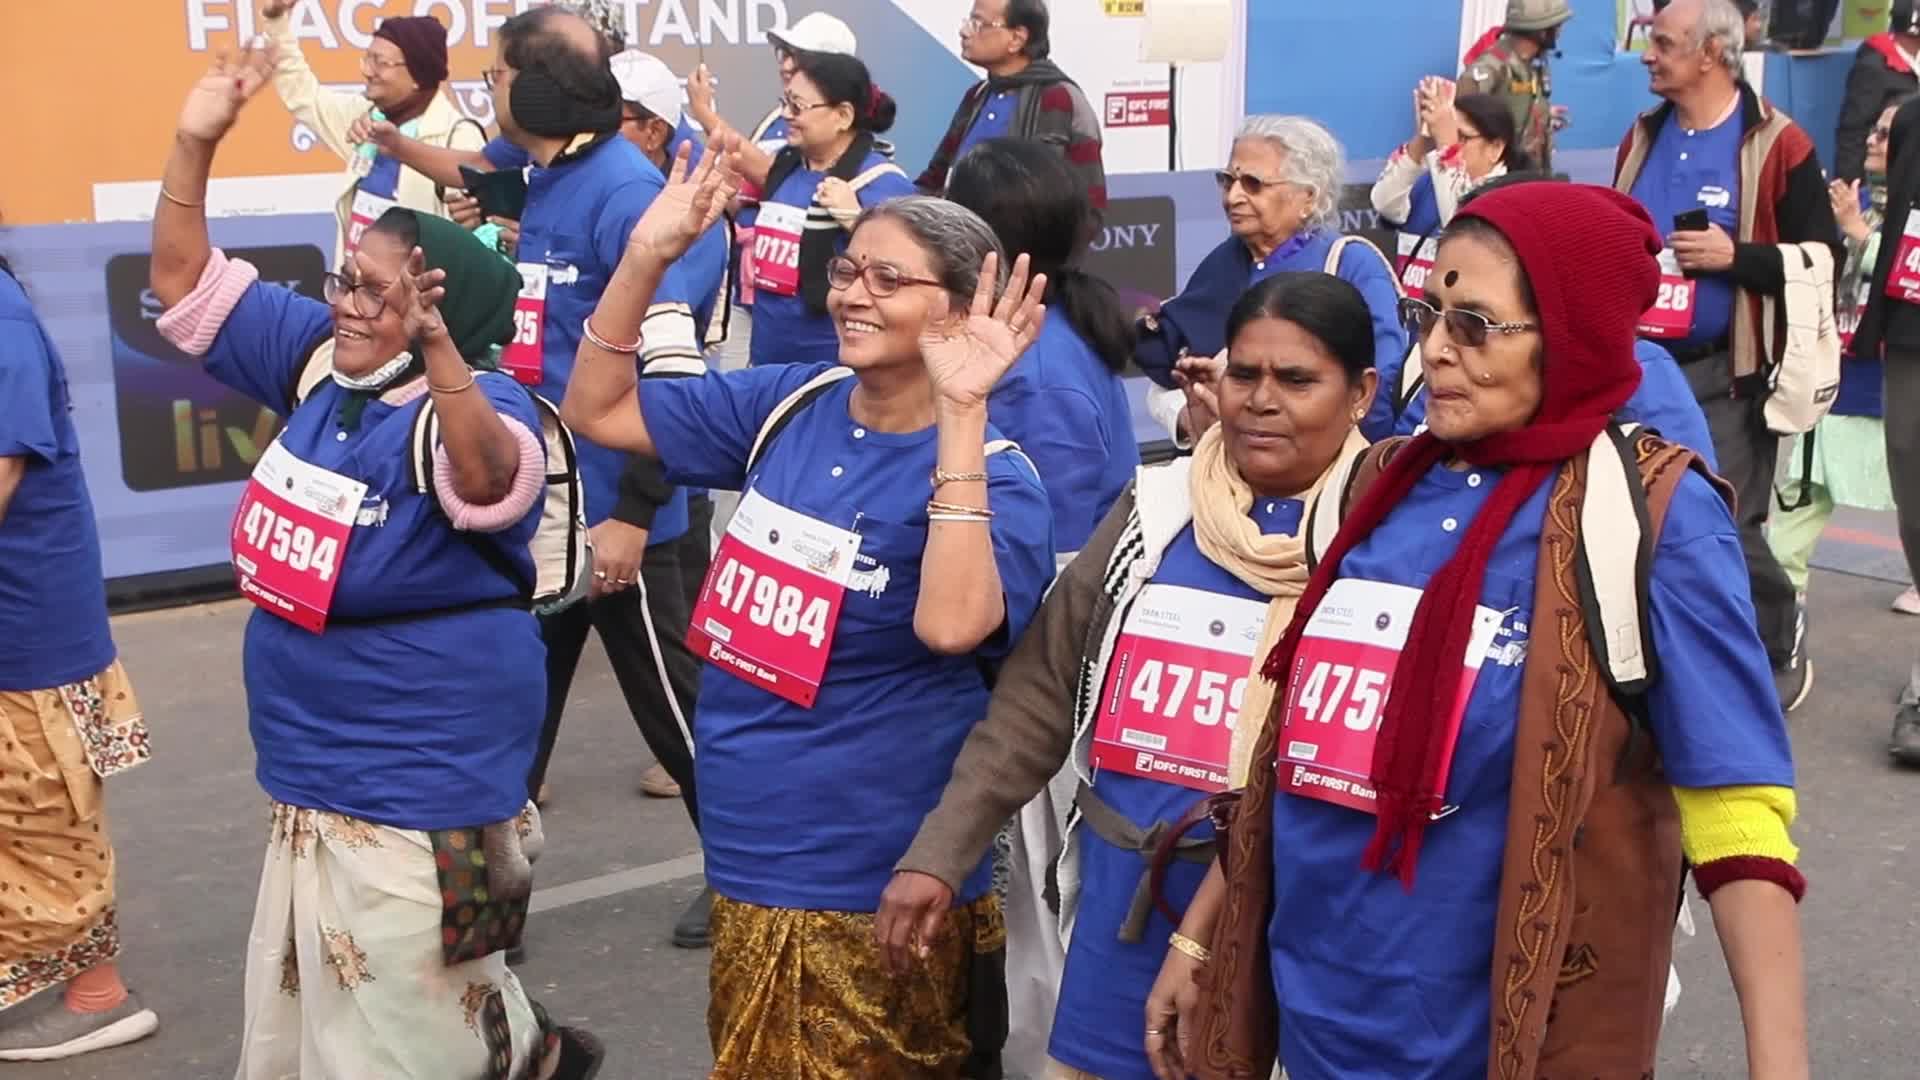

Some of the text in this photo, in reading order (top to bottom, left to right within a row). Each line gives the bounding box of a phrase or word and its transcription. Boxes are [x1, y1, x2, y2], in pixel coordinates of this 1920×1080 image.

[622, 0, 790, 46] TAND
[753, 234, 800, 269] 0173
[1089, 223, 1161, 251] ONY
[1655, 282, 1689, 311] 28
[243, 500, 339, 582] 47594
[715, 557, 831, 649] 47984
[735, 656, 757, 675] FIRST
[756, 667, 778, 684] Bank
[1130, 658, 1249, 730] 4759
[1298, 661, 1392, 732] 475
[1153, 759, 1229, 785] IDFC FIRST Ban
[1320, 774, 1349, 792] FIRST
